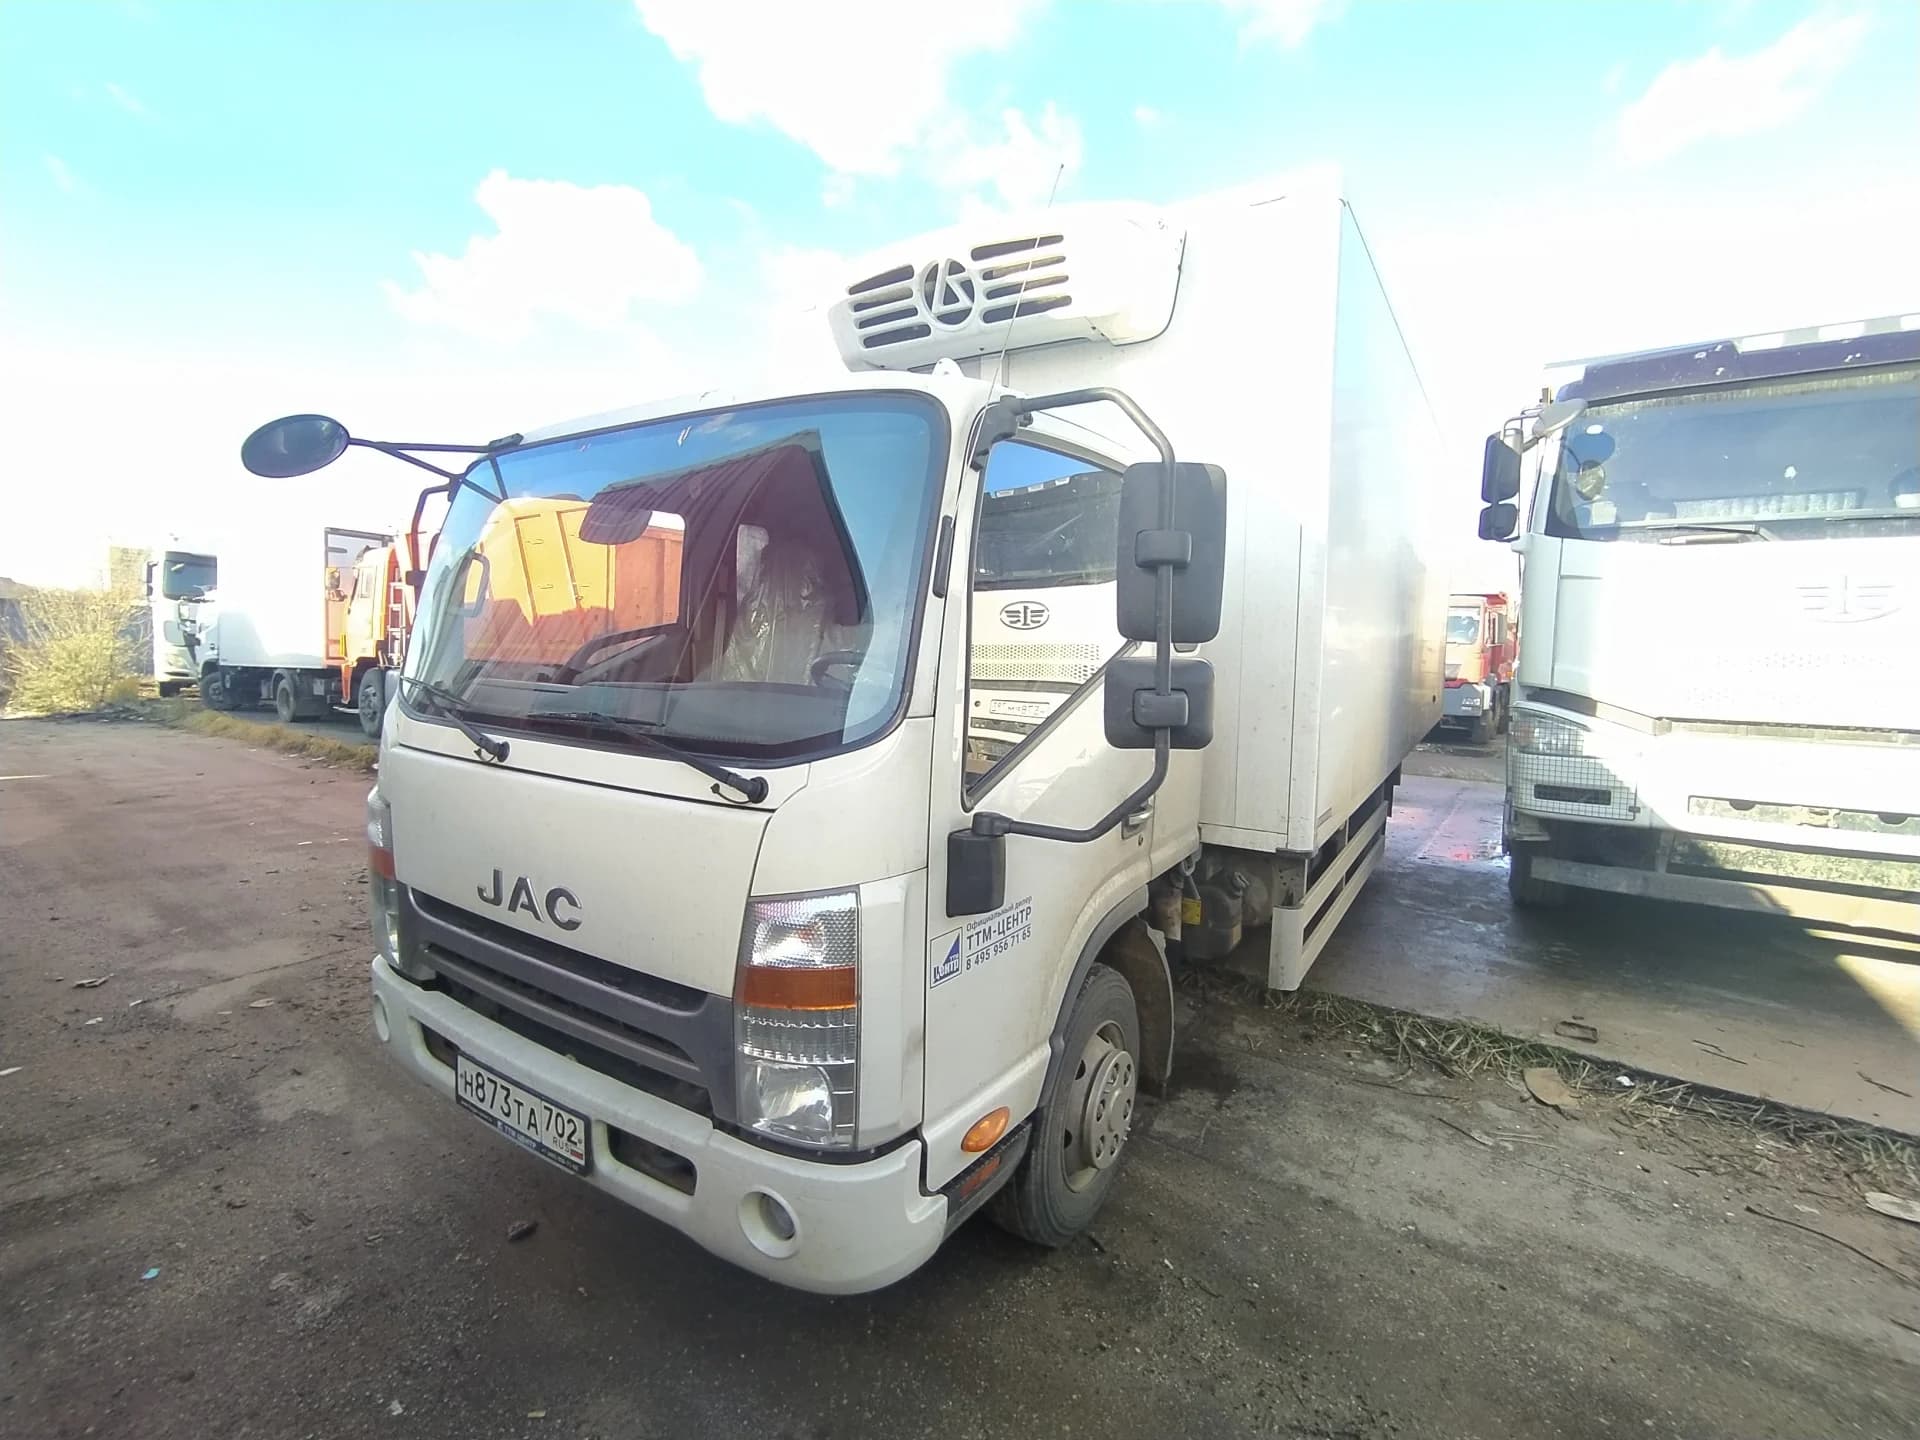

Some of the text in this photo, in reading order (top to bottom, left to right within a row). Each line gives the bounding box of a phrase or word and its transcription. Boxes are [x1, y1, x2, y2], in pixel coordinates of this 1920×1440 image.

[477, 868, 582, 931] JAC
[966, 906, 1032, 950] ТТМ-ЦЕНТР
[974, 949, 991, 966] 495
[993, 942, 1009, 956] 956
[1011, 935, 1020, 947] 71
[1022, 927, 1031, 941] 65
[553, 1136, 570, 1152] RUS
